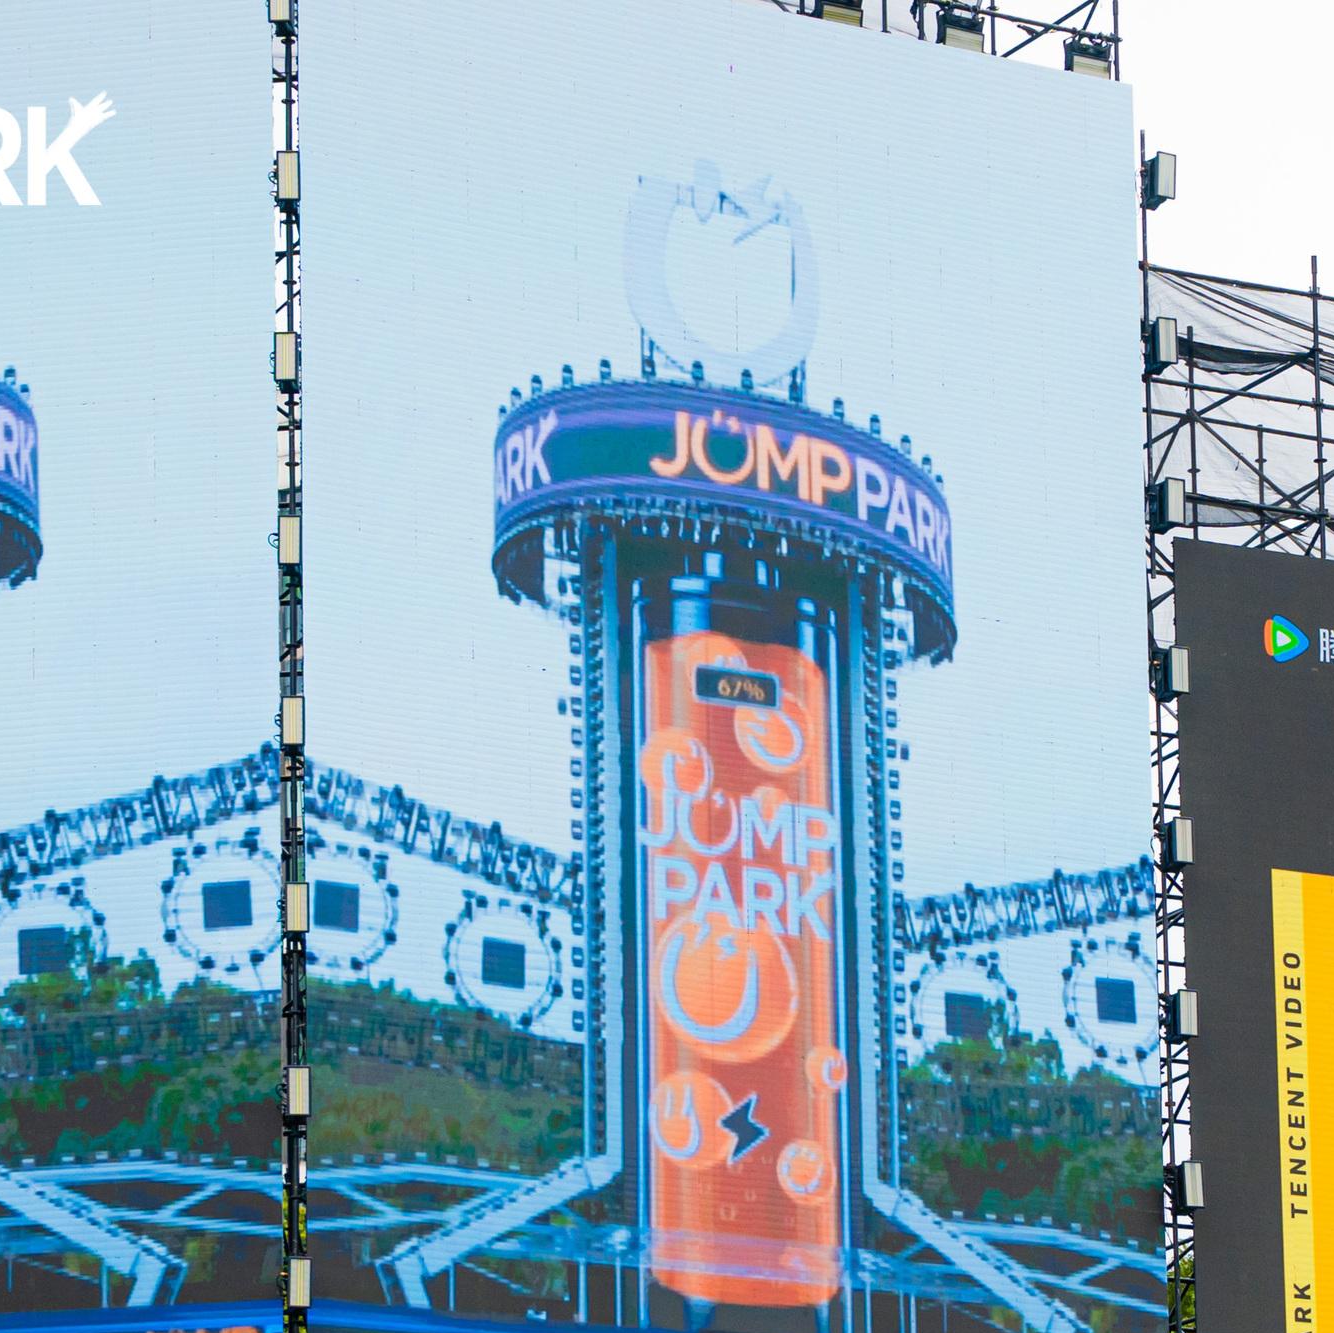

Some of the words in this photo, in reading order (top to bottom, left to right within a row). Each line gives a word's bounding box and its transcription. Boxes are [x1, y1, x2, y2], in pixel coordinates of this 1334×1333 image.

[653, 856, 835, 940] PARK
[1283, 952, 1303, 1049] VIDEO
[1287, 1067, 1308, 1218] TENCENT
